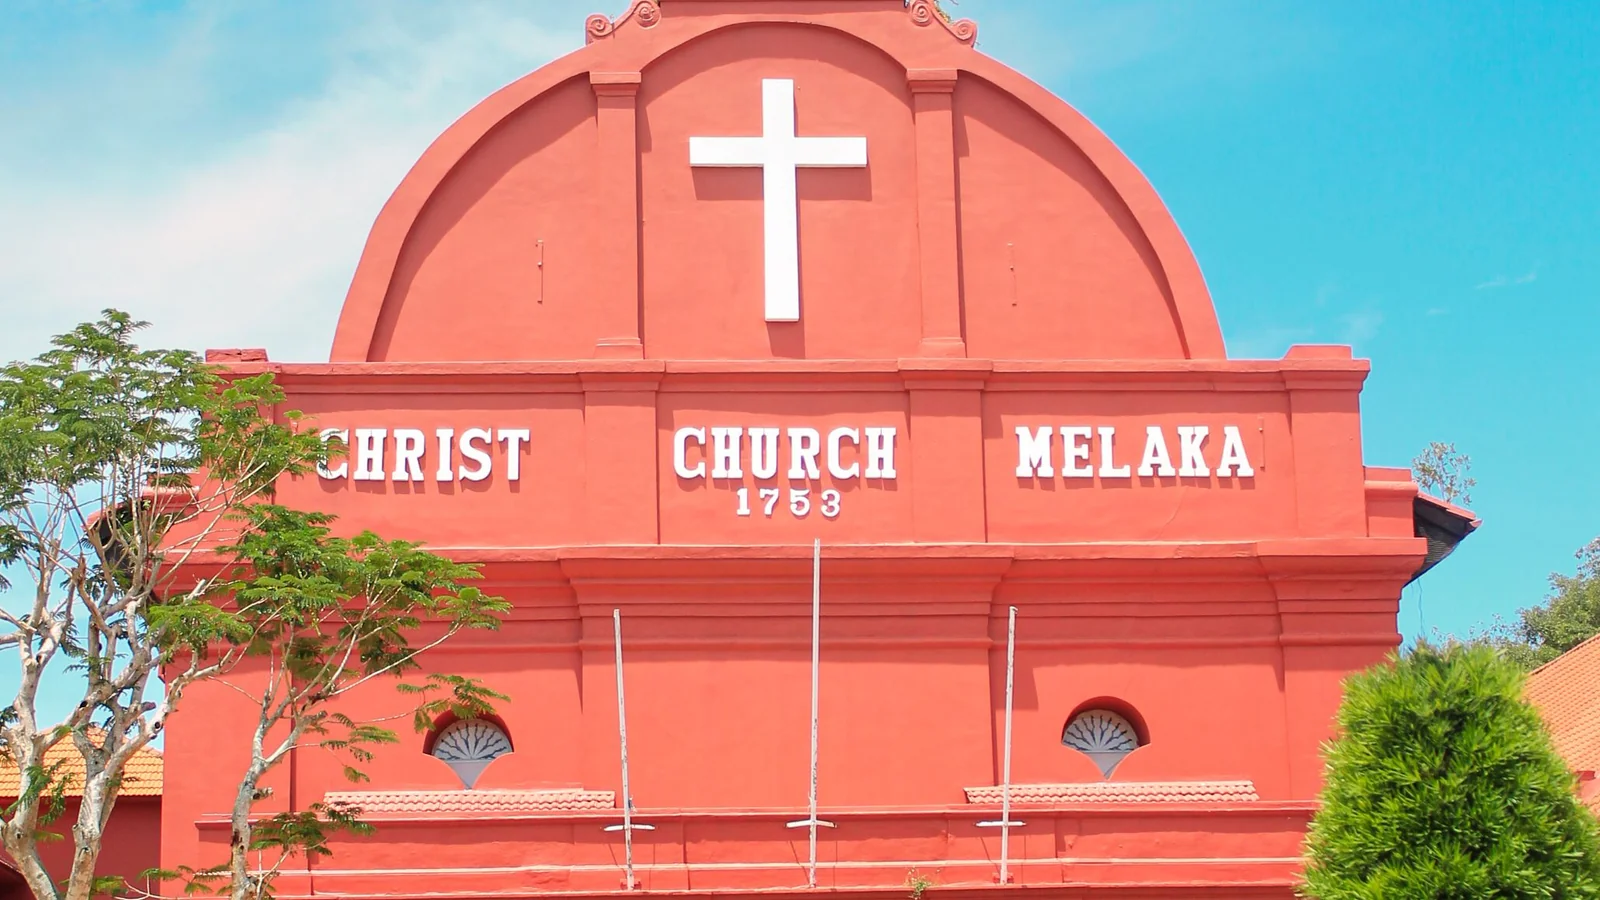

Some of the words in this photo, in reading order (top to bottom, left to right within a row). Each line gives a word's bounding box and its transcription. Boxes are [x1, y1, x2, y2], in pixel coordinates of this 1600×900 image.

[316, 426, 531, 481] CHRIST
[672, 425, 897, 480] CHURCH
[1014, 424, 1255, 478] MELAKA
[735, 487, 841, 518] 1753
